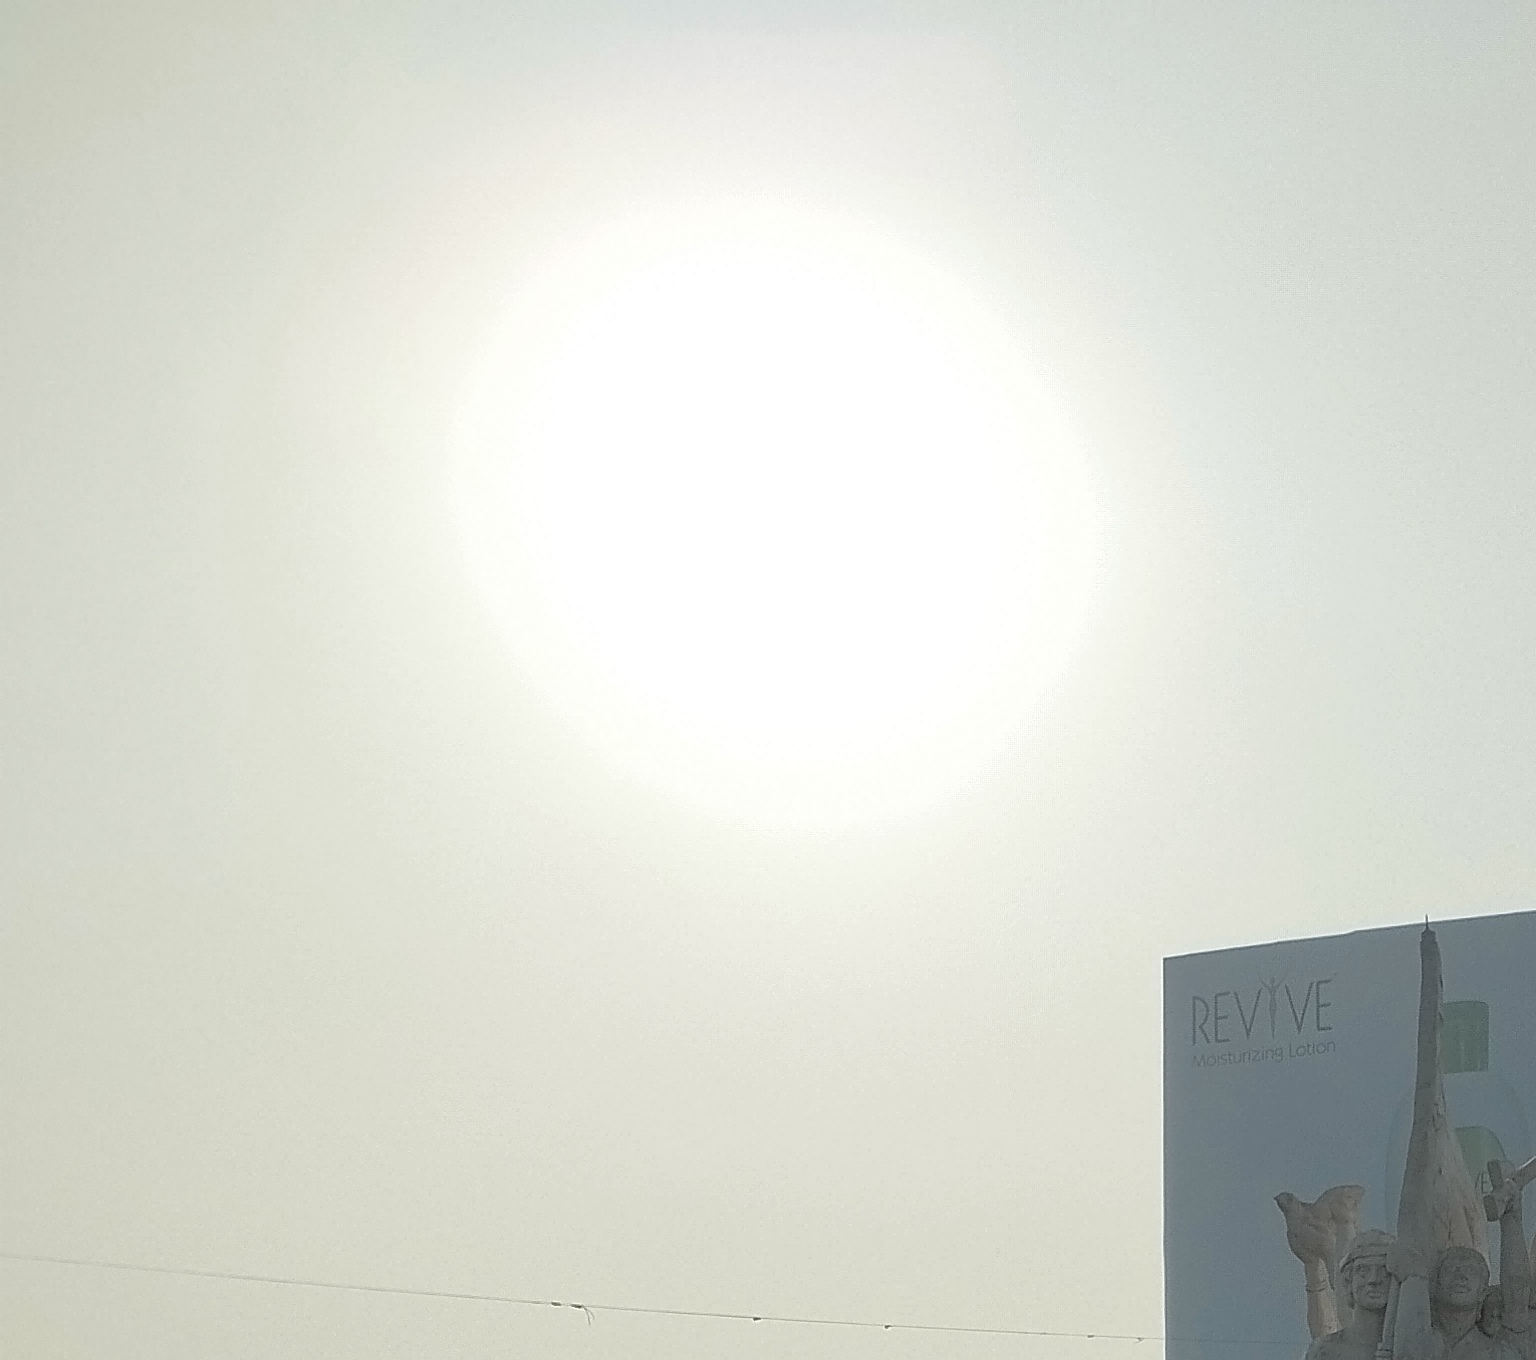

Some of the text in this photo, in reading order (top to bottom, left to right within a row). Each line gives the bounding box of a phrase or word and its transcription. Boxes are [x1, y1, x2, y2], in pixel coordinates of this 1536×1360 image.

[1190, 974, 1334, 1047] REVIVE
[1191, 1040, 1336, 1069] Moisturizing Lotion
